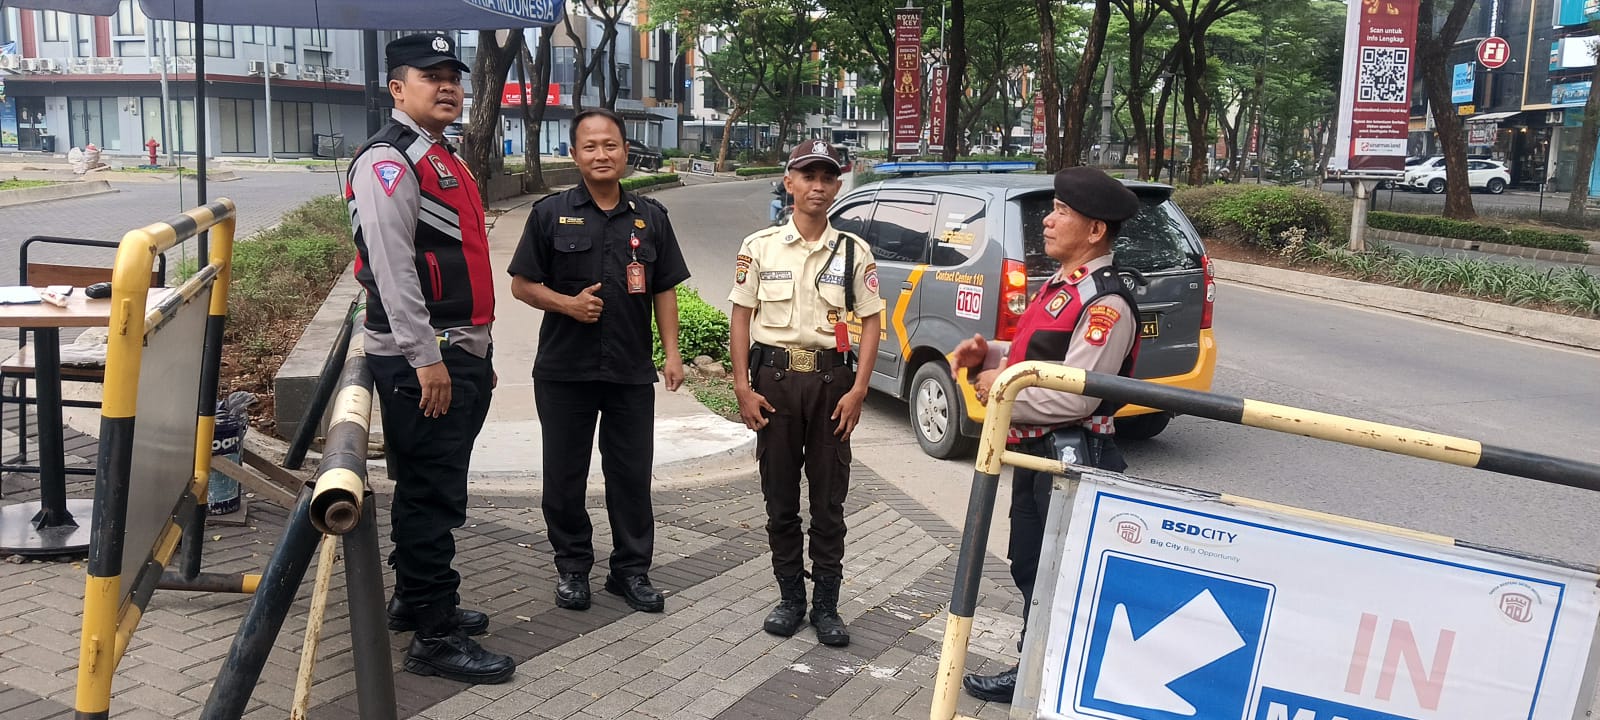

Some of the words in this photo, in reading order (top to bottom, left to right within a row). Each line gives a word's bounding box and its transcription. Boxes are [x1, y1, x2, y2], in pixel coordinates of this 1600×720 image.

[497, 0, 553, 20] INDONESIA
[934, 69, 943, 113] ROYAL
[932, 117, 941, 144] KEY
[936, 270, 955, 282] Contact
[955, 272, 973, 284] Center
[974, 273, 984, 286] 110
[958, 292, 980, 313] 110
[1143, 324, 1155, 334] 41
[1150, 538, 1163, 548] Big
[1184, 546, 1196, 554] Big
[1197, 548, 1241, 563] Opportunity
[1344, 612, 1457, 711] IN
